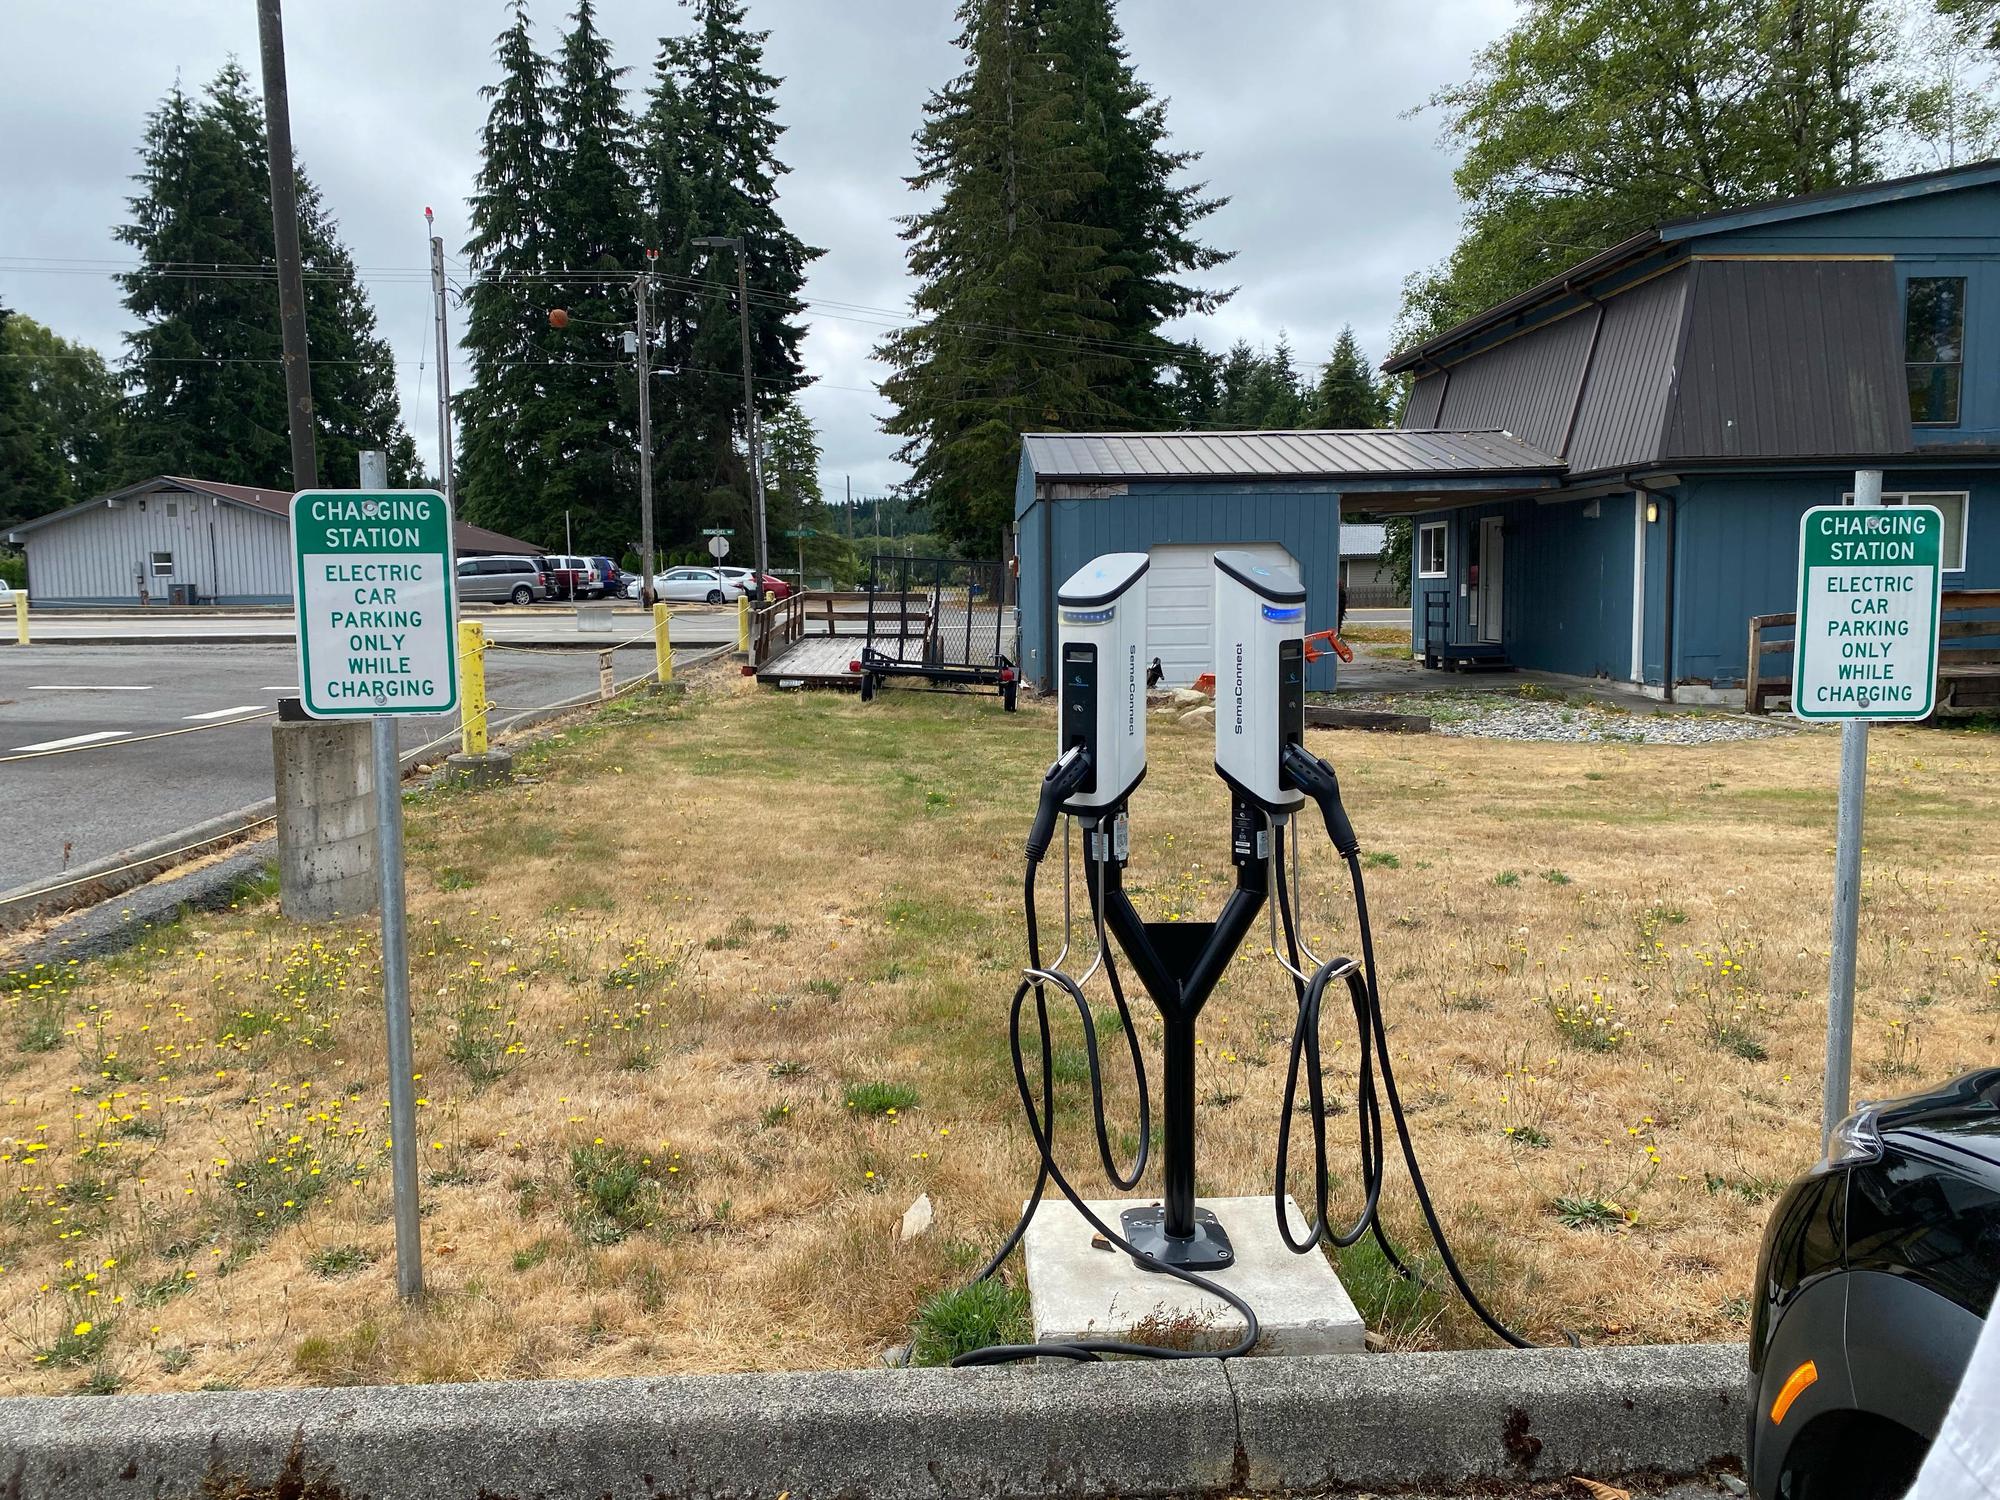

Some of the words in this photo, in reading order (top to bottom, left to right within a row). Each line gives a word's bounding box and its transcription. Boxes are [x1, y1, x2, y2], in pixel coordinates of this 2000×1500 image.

[326, 528, 419, 548] STATION
[1830, 542, 1915, 560] STATION
[326, 564, 422, 582] ELECTRIC
[1827, 576, 1914, 593] ELECTRIC
[354, 588, 396, 605] CAR
[1851, 599, 1888, 615] CAR
[332, 611, 422, 629] PARKING
[1828, 621, 1909, 637] PARKING
[350, 634, 406, 651] ONLY
[1842, 643, 1893, 658] ONLY
[348, 657, 411, 675] WHILE
[1838, 664, 1894, 680] WHILE
[327, 680, 434, 698] CHARGING
[1235, 643, 1243, 735] SemaConnect
[1817, 686, 1912, 702] CHARGING
